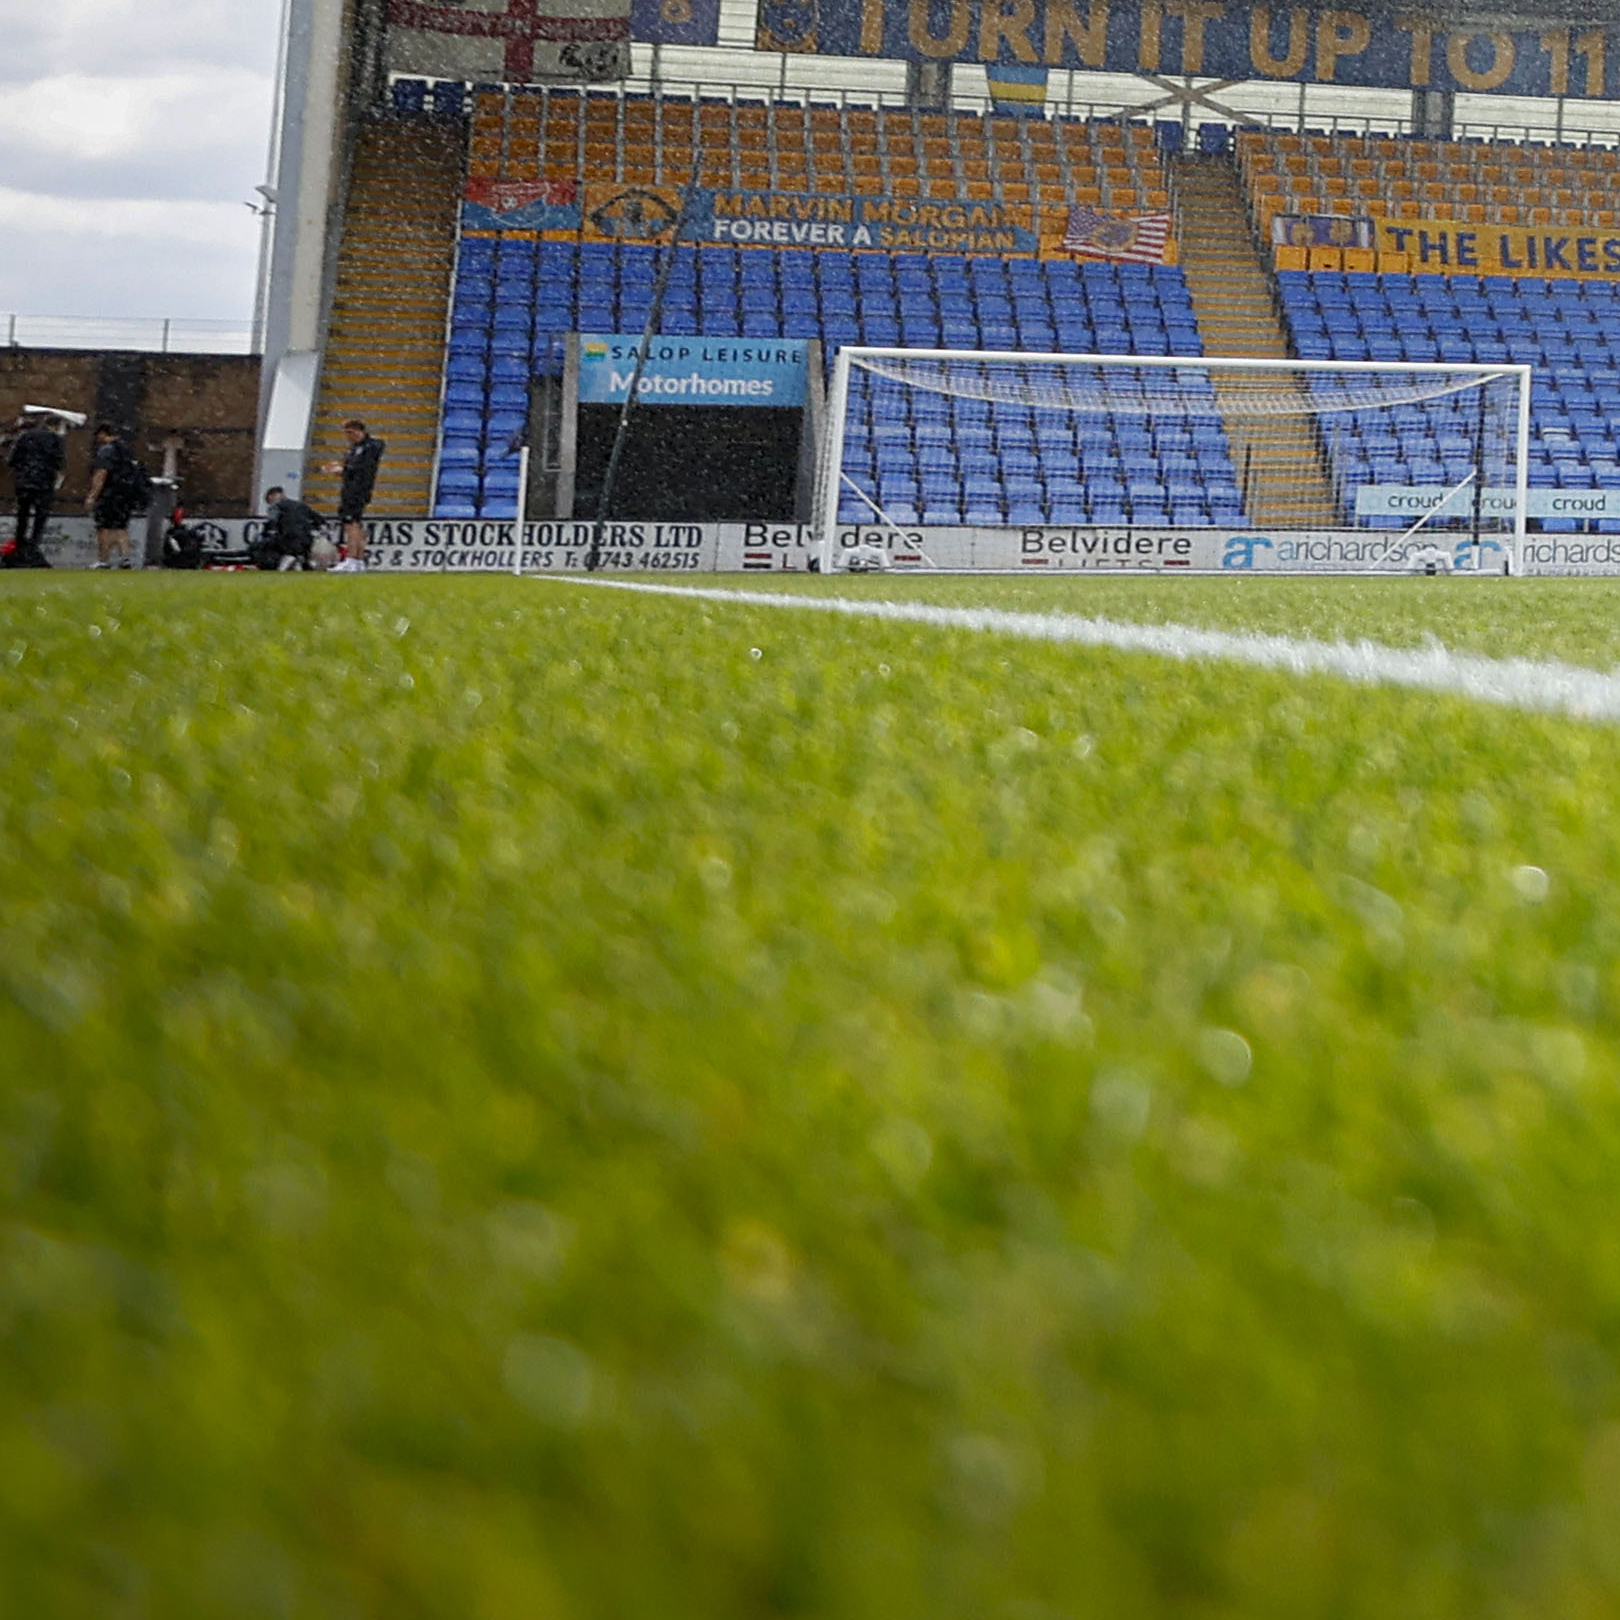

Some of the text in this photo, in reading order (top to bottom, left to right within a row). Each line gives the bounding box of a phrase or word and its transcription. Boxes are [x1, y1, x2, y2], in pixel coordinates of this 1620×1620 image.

[1250, 6, 1371, 81] UP
[1394, 14, 1516, 91] TO
[1540, 26, 1606, 96] 11
[713, 191, 853, 222] MARVIN
[713, 217, 1016, 249] FOREVER A SALOPIAN
[1386, 225, 1478, 268] THE
[612, 345, 801, 364] SALOP LEISURE
[610, 371, 774, 396] Motorhomes
[1552, 495, 1607, 512] croud
[423, 522, 645, 549] STOCKHOLDERS
[653, 524, 702, 548] LTD
[1021, 529, 1192, 555] Belvidere
[391, 550, 405, 567] &
[639, 552, 700, 569] 462515
